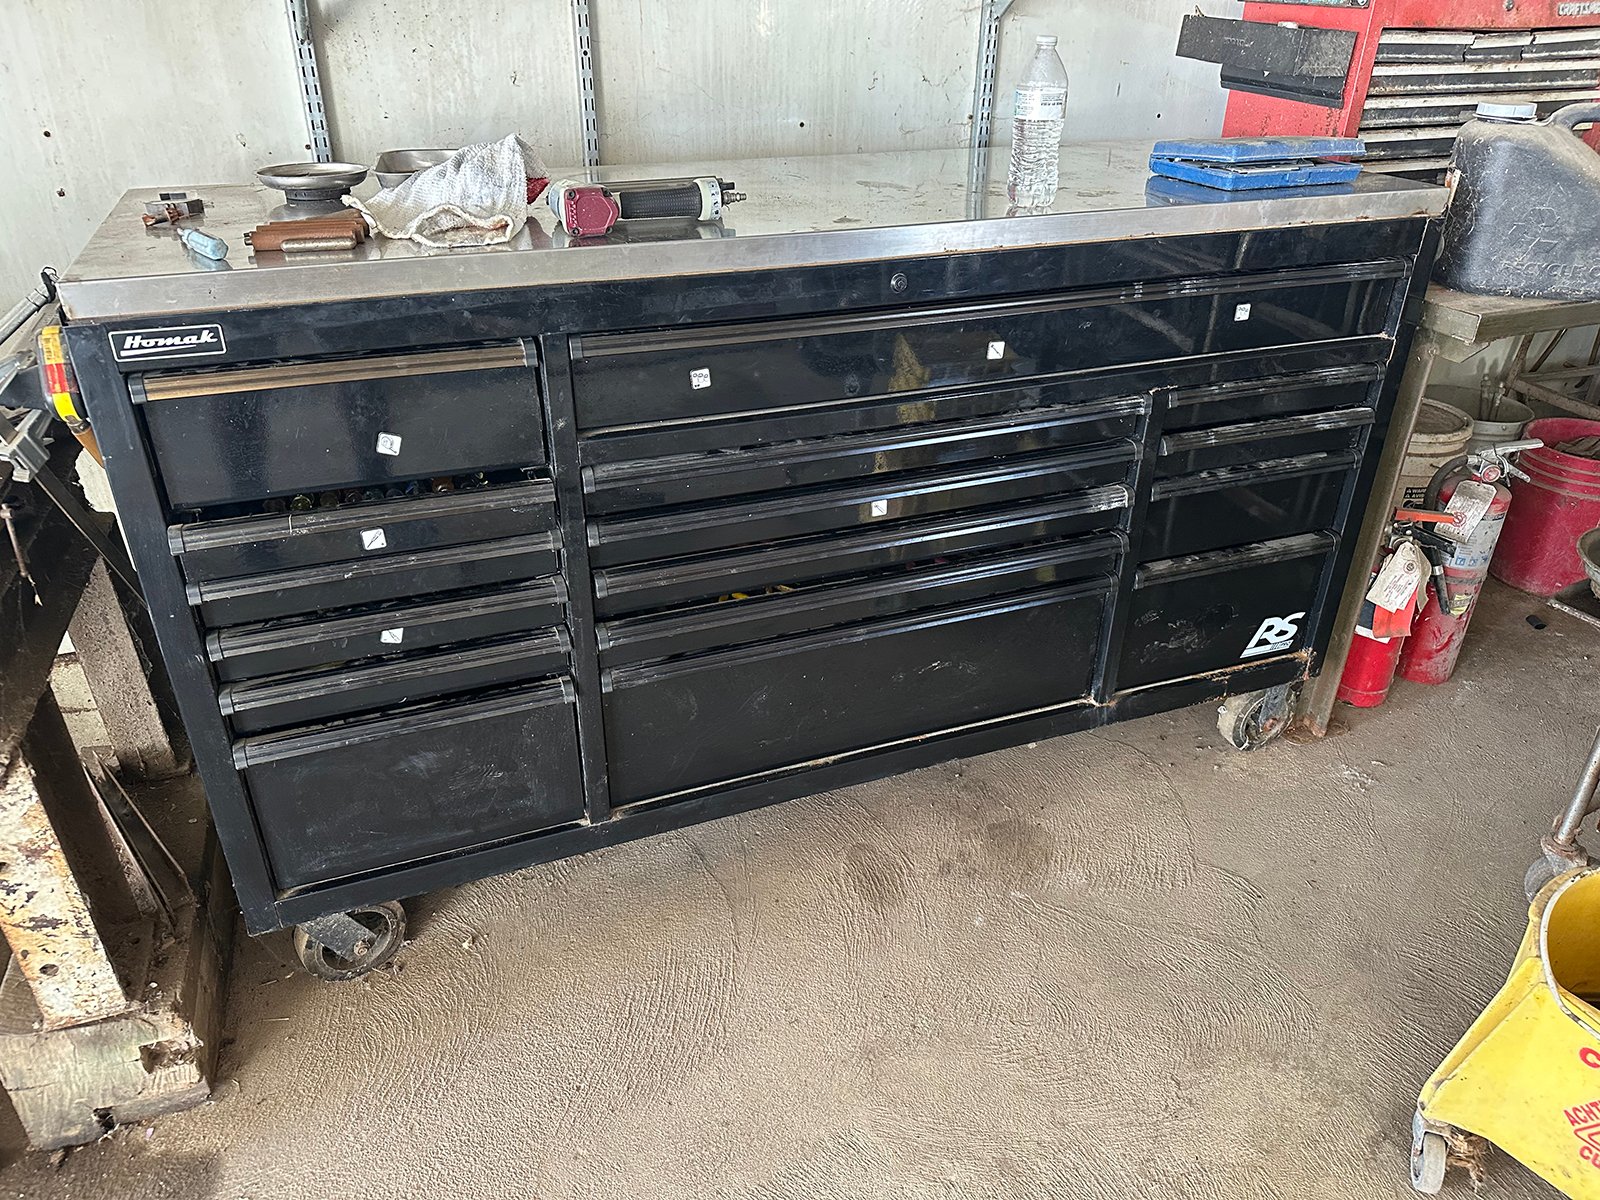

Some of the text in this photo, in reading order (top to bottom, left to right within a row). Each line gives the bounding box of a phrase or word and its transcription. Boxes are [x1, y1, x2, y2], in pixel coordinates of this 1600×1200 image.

[123, 329, 218, 349] Homak
[1246, 611, 1307, 649] RS
[1563, 1100, 1600, 1127] ACHT
